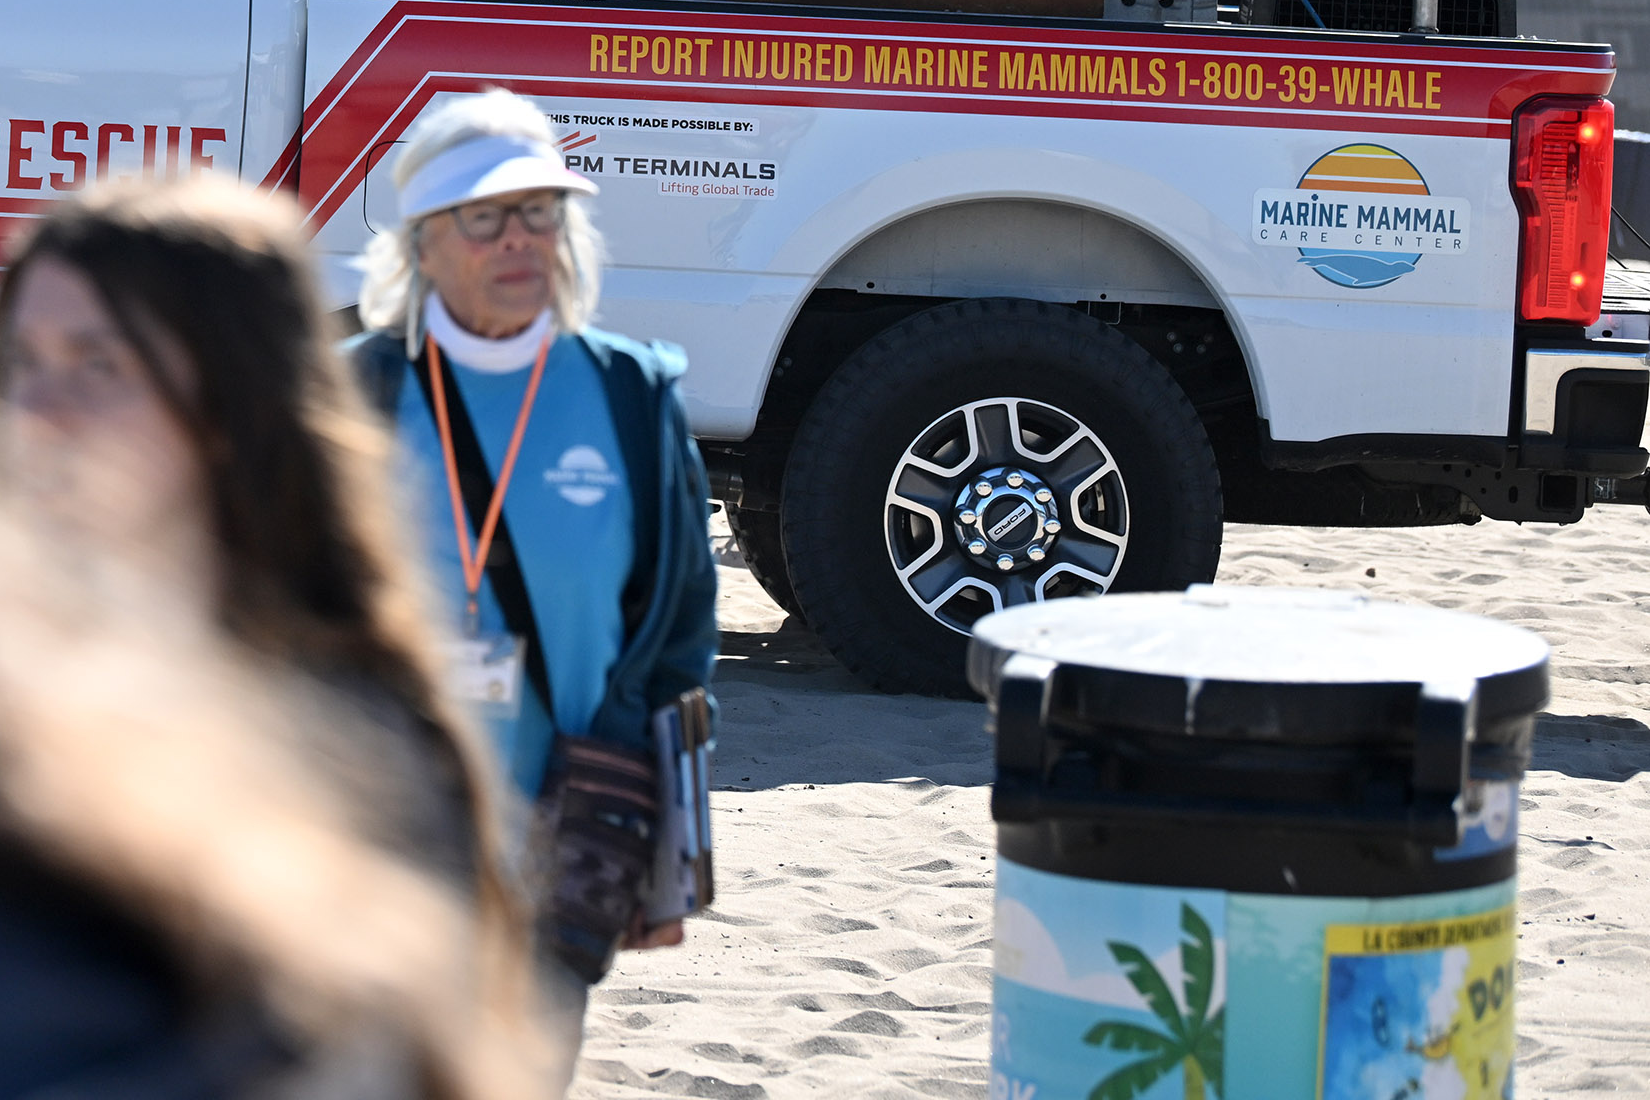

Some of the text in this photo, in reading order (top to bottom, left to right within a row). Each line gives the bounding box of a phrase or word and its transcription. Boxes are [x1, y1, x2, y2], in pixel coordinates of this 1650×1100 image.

[589, 33, 1442, 110] REPORT INJURED MARINE MAMMALS 1-800-39-WHALE
[573, 114, 615, 126] TRUCK
[618, 117, 629, 127] IS
[633, 116, 669, 129] MADE
[671, 119, 731, 131] POSSIBLE
[734, 121, 754, 132] BY:
[564, 154, 776, 180] PM TERMINALS
[661, 181, 775, 197] Lifting Global Trade
[1260, 193, 1461, 234] MARINE MAMMAL
[1260, 229, 1462, 249] CARE CENTER
[993, 507, 1027, 536] FORD
